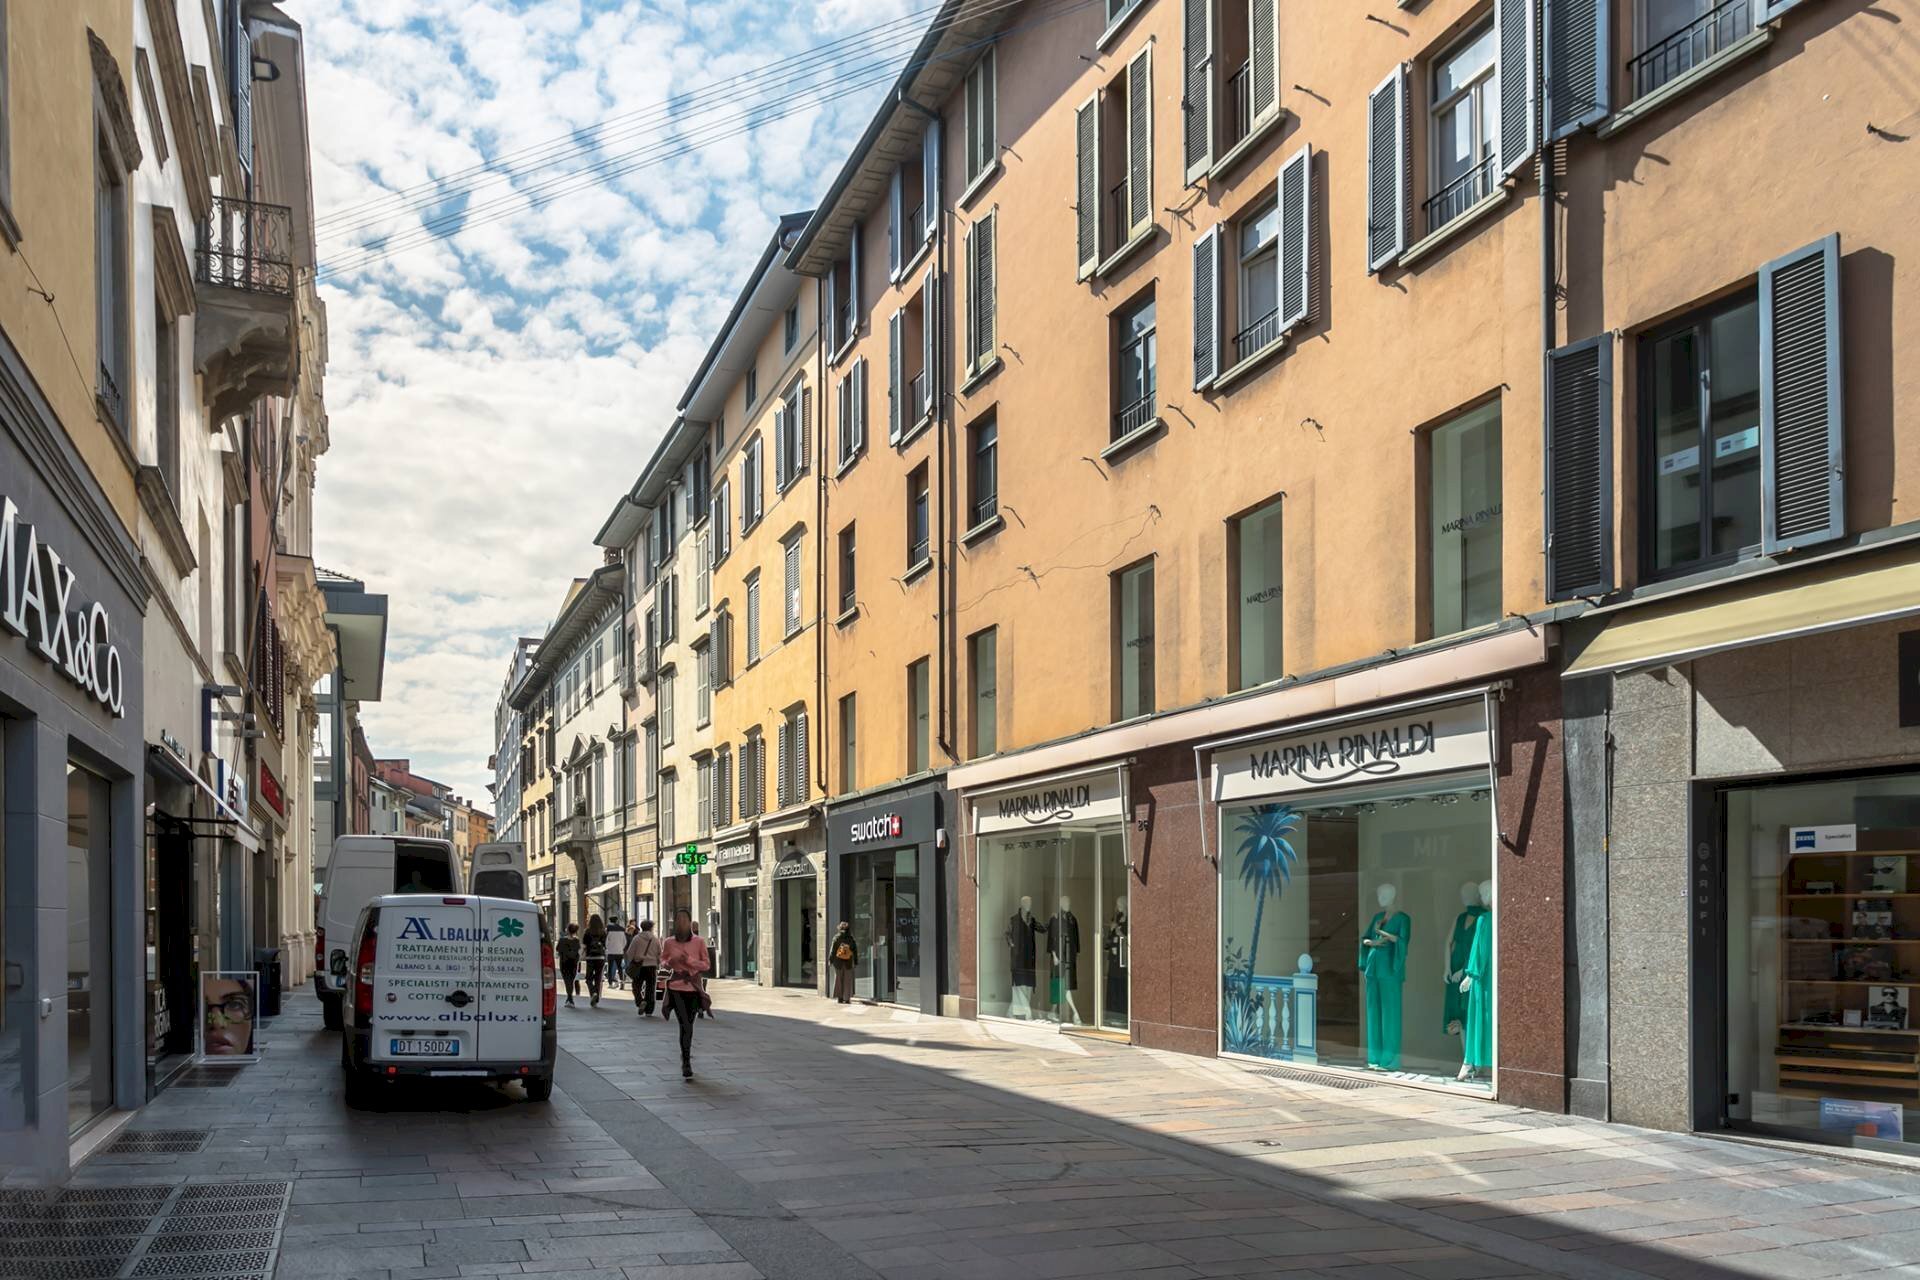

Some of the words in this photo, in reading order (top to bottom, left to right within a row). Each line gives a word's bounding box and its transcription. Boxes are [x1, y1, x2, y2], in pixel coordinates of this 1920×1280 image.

[1250, 740, 1334, 782] MARINA
[1338, 721, 1435, 768] RINALDI
[999, 793, 1041, 819] MARINA
[1043, 784, 1091, 813] RINALDI
[850, 813, 892, 842] swatch
[1697, 842, 1710, 937] GARUFI
[396, 916, 490, 942] ALBALUX
[396, 943, 468, 954] TRATTAMENTI
[472, 946, 484, 954] IN
[487, 946, 524, 955] RESINA
[388, 979, 449, 988] SPECIALISTI
[455, 981, 530, 989] TRATTAMENTO
[408, 992, 446, 1000] COTTO
[495, 994, 529, 1002] PIETRA
[378, 1011, 538, 1023] www.albalux.it
[399, 1040, 412, 1052] DT
